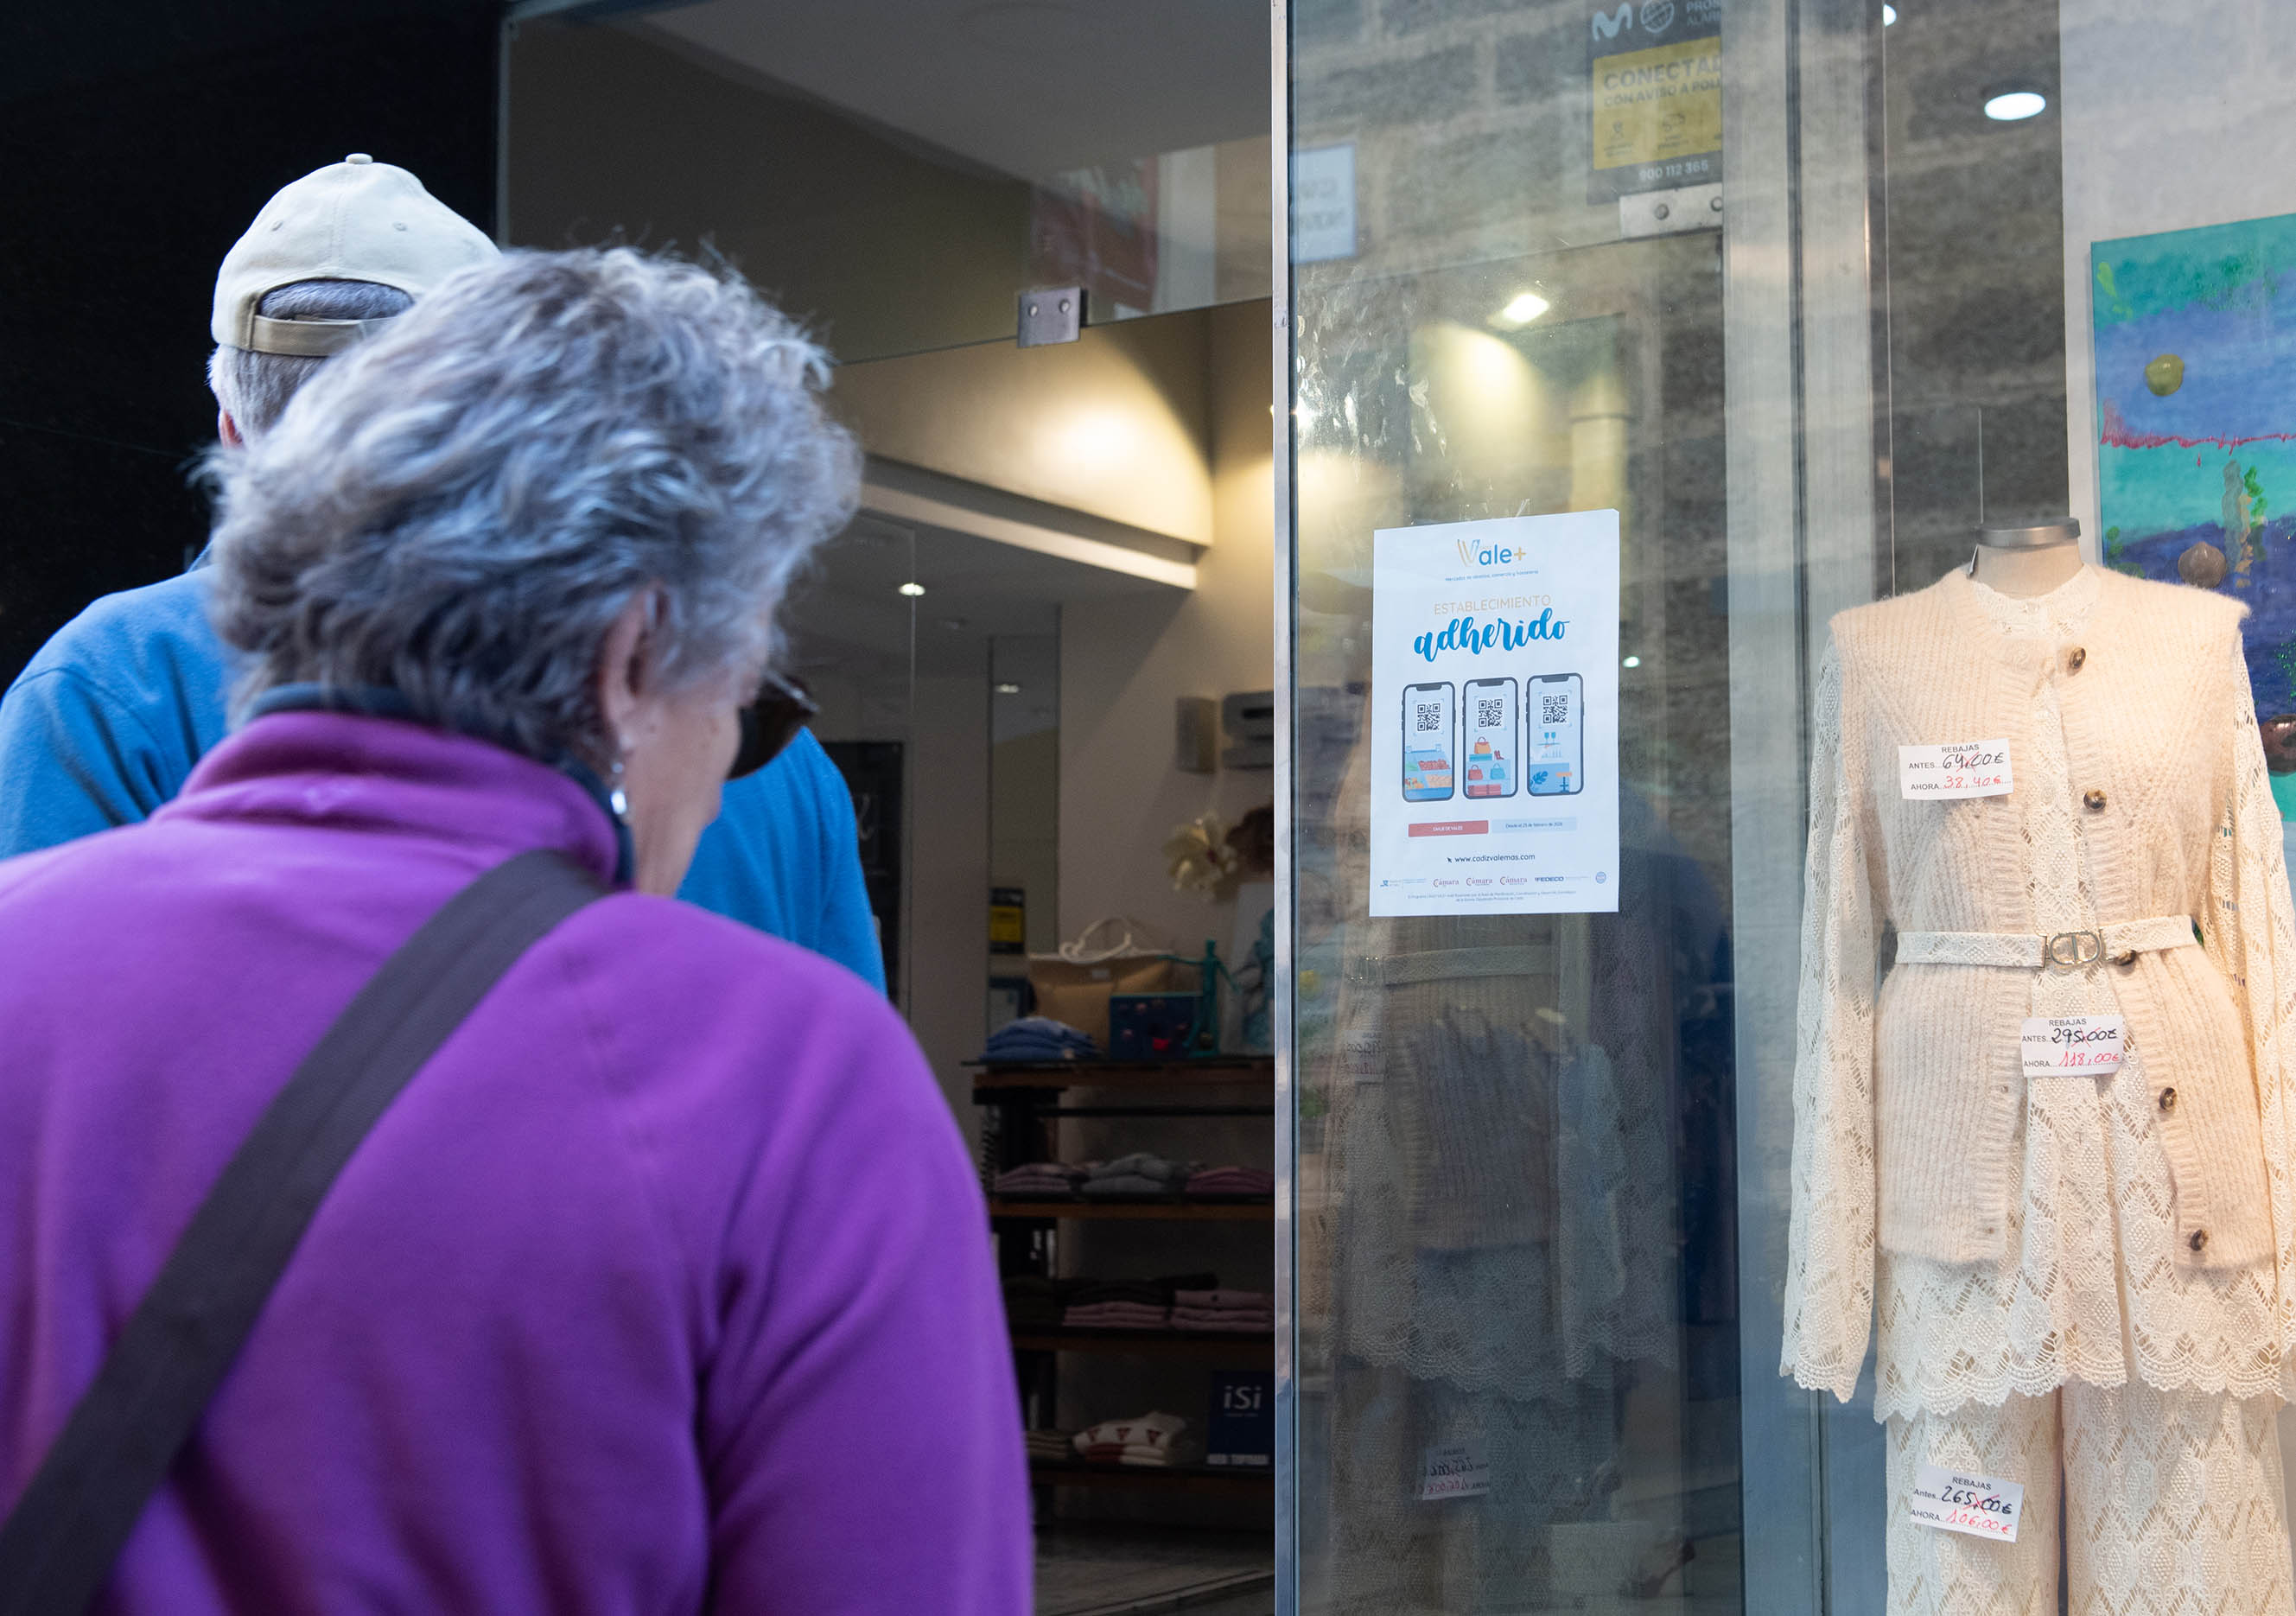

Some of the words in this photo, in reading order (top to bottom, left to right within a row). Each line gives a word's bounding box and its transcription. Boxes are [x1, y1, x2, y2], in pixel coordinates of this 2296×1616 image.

[1434, 594, 1552, 616] ESTABLECIMIENTO
[1414, 608, 1571, 663] adherido
[1941, 744, 1980, 754] REBAJAS
[1454, 853, 1536, 863] www.cadizvalemas.com
[2048, 1018, 2087, 1027] REBAJAS
[1952, 1476, 1992, 1491] REBAJAS
[1913, 1488, 1937, 1499] Antes
[1911, 1509, 1941, 1522] AHORA
